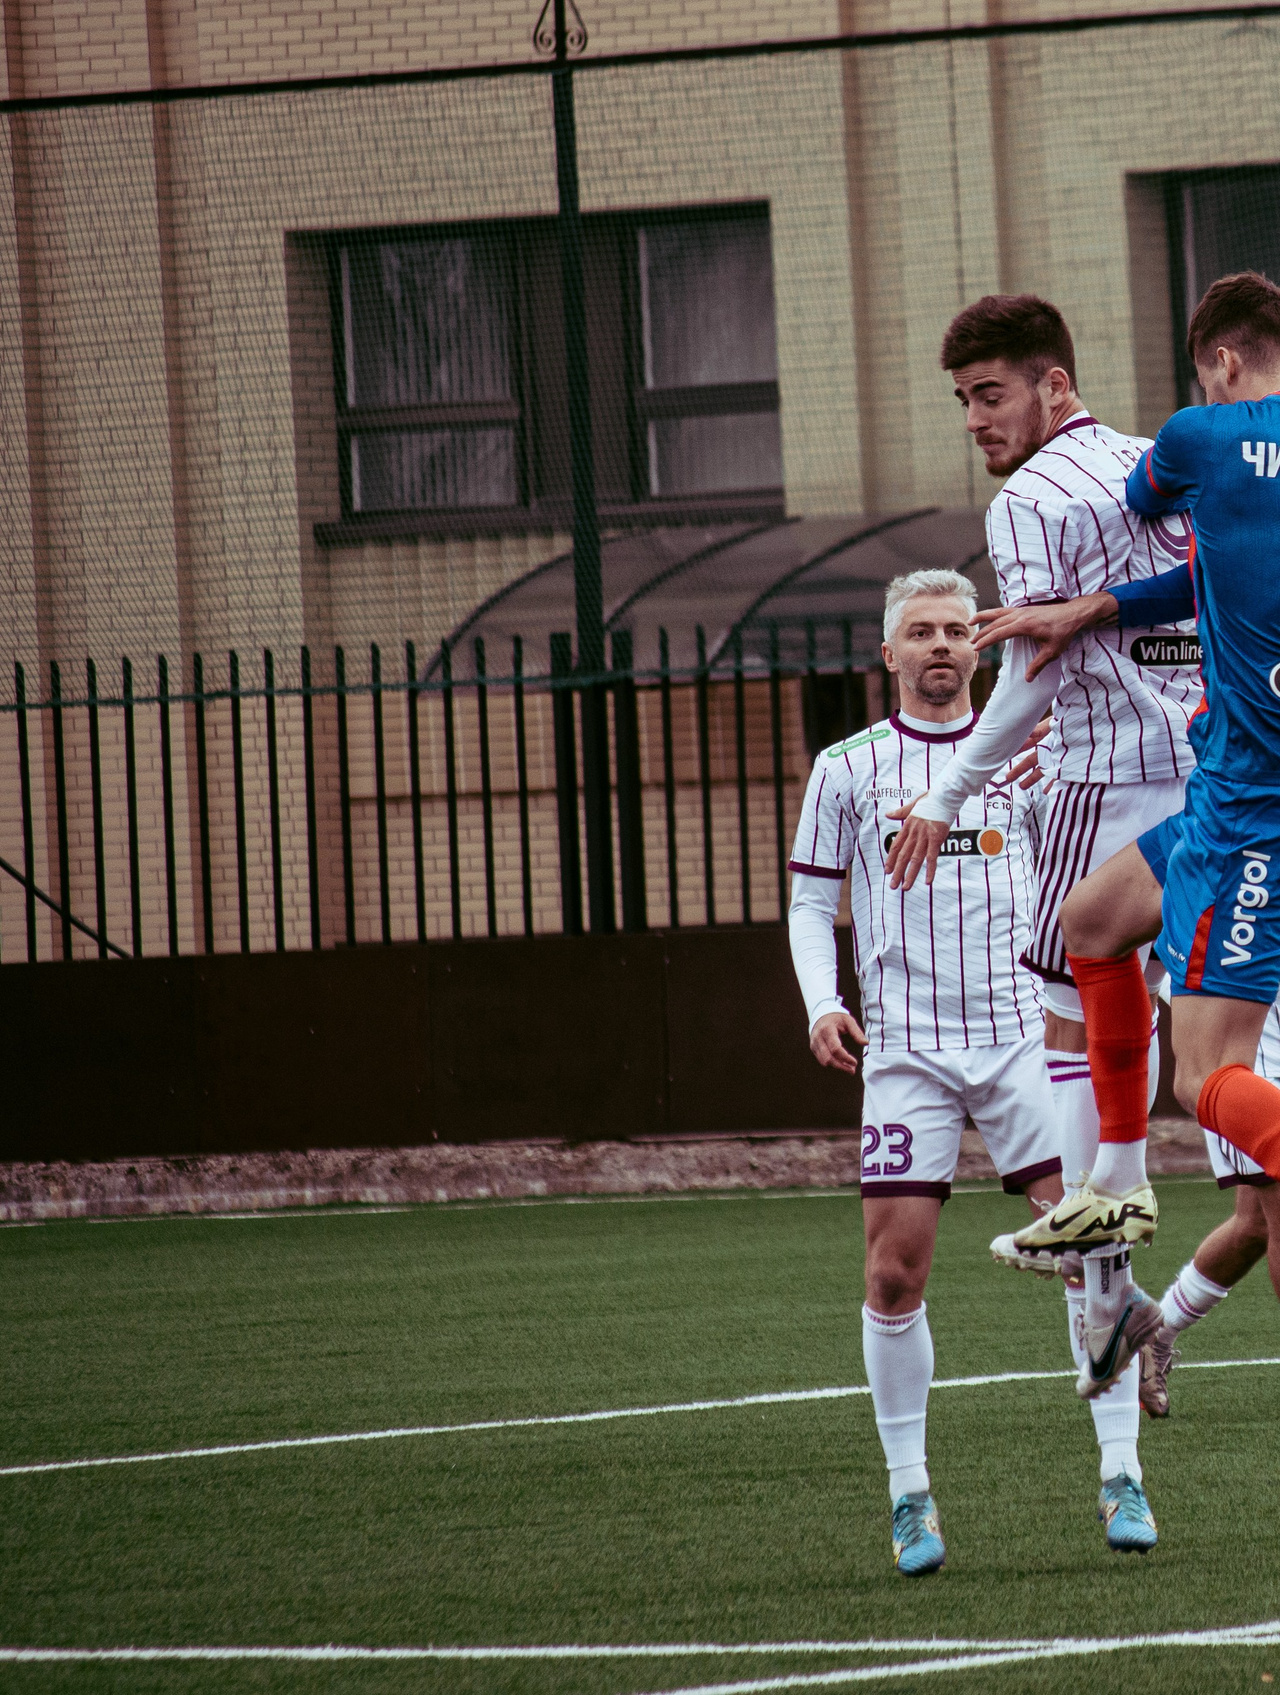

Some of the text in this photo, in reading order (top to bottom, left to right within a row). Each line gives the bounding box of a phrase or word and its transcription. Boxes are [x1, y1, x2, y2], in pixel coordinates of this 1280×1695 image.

[865, 787, 912, 800] UNAFFECTED
[986, 801, 1011, 811] FC 10
[1220, 850, 1271, 966] Vorgol
[862, 1123, 913, 1177] 23
